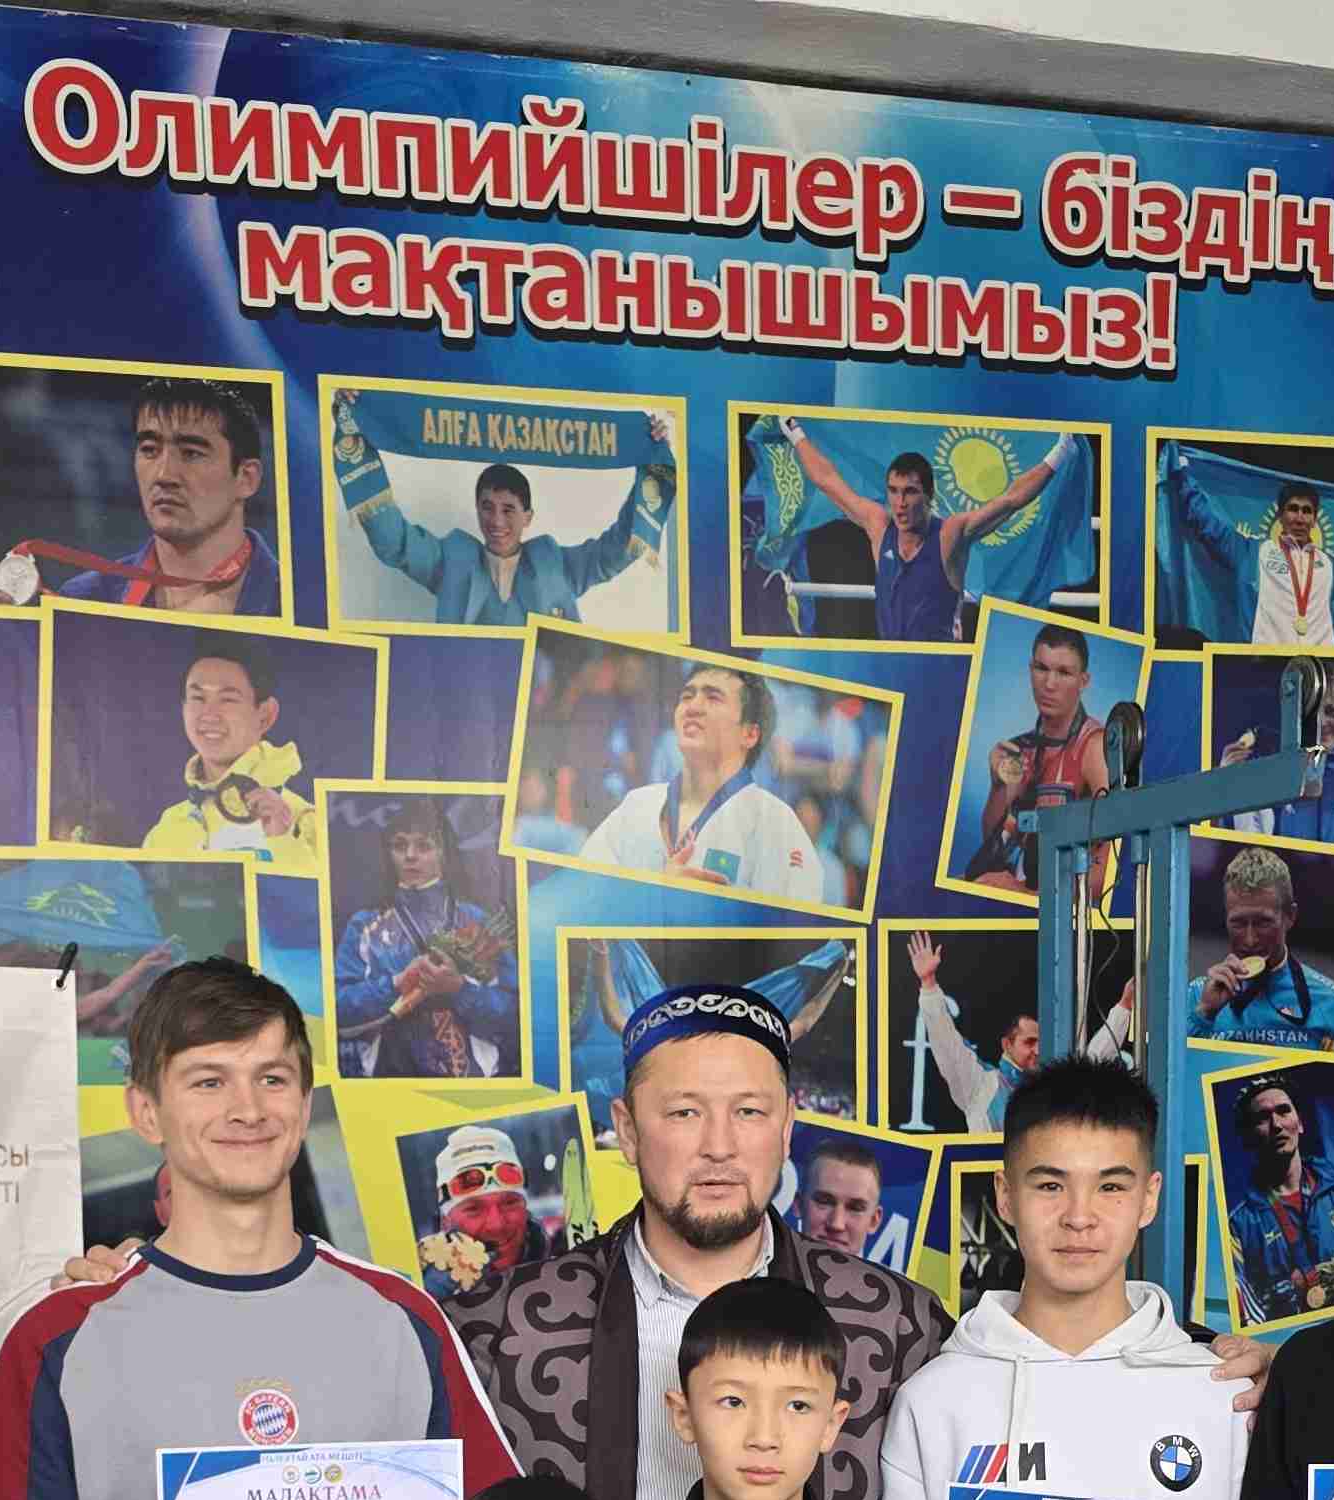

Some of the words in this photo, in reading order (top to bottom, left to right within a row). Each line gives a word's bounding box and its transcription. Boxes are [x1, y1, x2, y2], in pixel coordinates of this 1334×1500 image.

[22, 56, 926, 255] Олимпийшілер
[237, 220, 1178, 369] мақтанышымыз!
[486, 413, 617, 457] ҚАЗАҚСТАН
[1155, 1436, 1199, 1458] BMW
